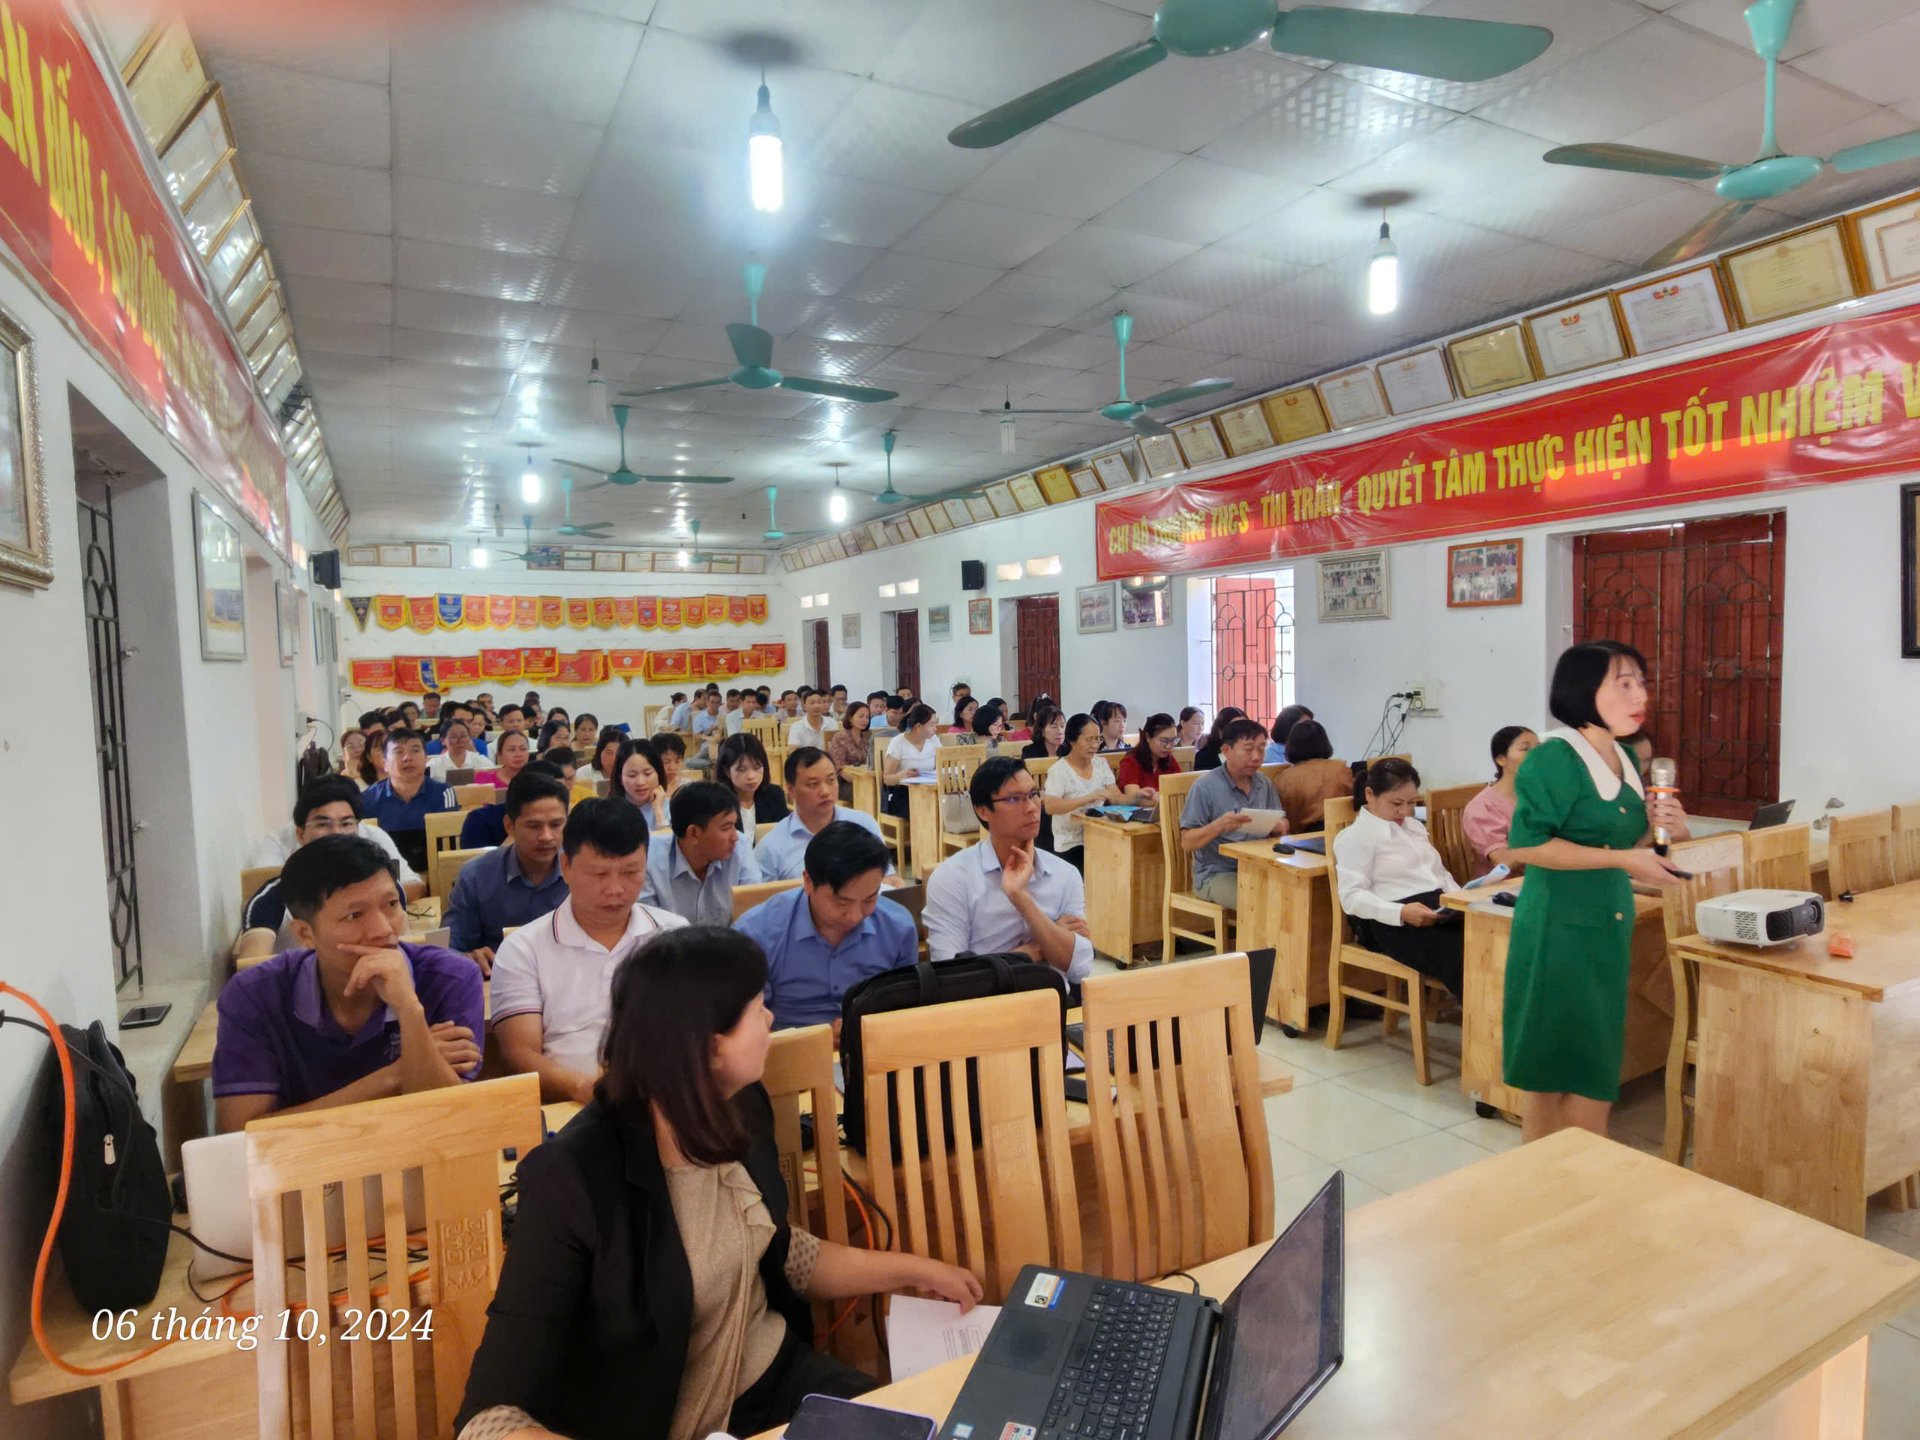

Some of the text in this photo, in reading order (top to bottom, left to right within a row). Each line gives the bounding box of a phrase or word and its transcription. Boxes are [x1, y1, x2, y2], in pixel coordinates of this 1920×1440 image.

[1109, 523, 1129, 555] CHI
[1210, 500, 1250, 538] THCS
[1292, 472, 1342, 522] TRẤN
[1357, 452, 1426, 516] QUYẾT
[1432, 448, 1487, 500] TÂM
[1492, 433, 1565, 493] THỰC
[1574, 414, 1652, 480] HIỆN
[1661, 386, 1729, 460] TỐT
[1740, 367, 1885, 448] NHIỆM
